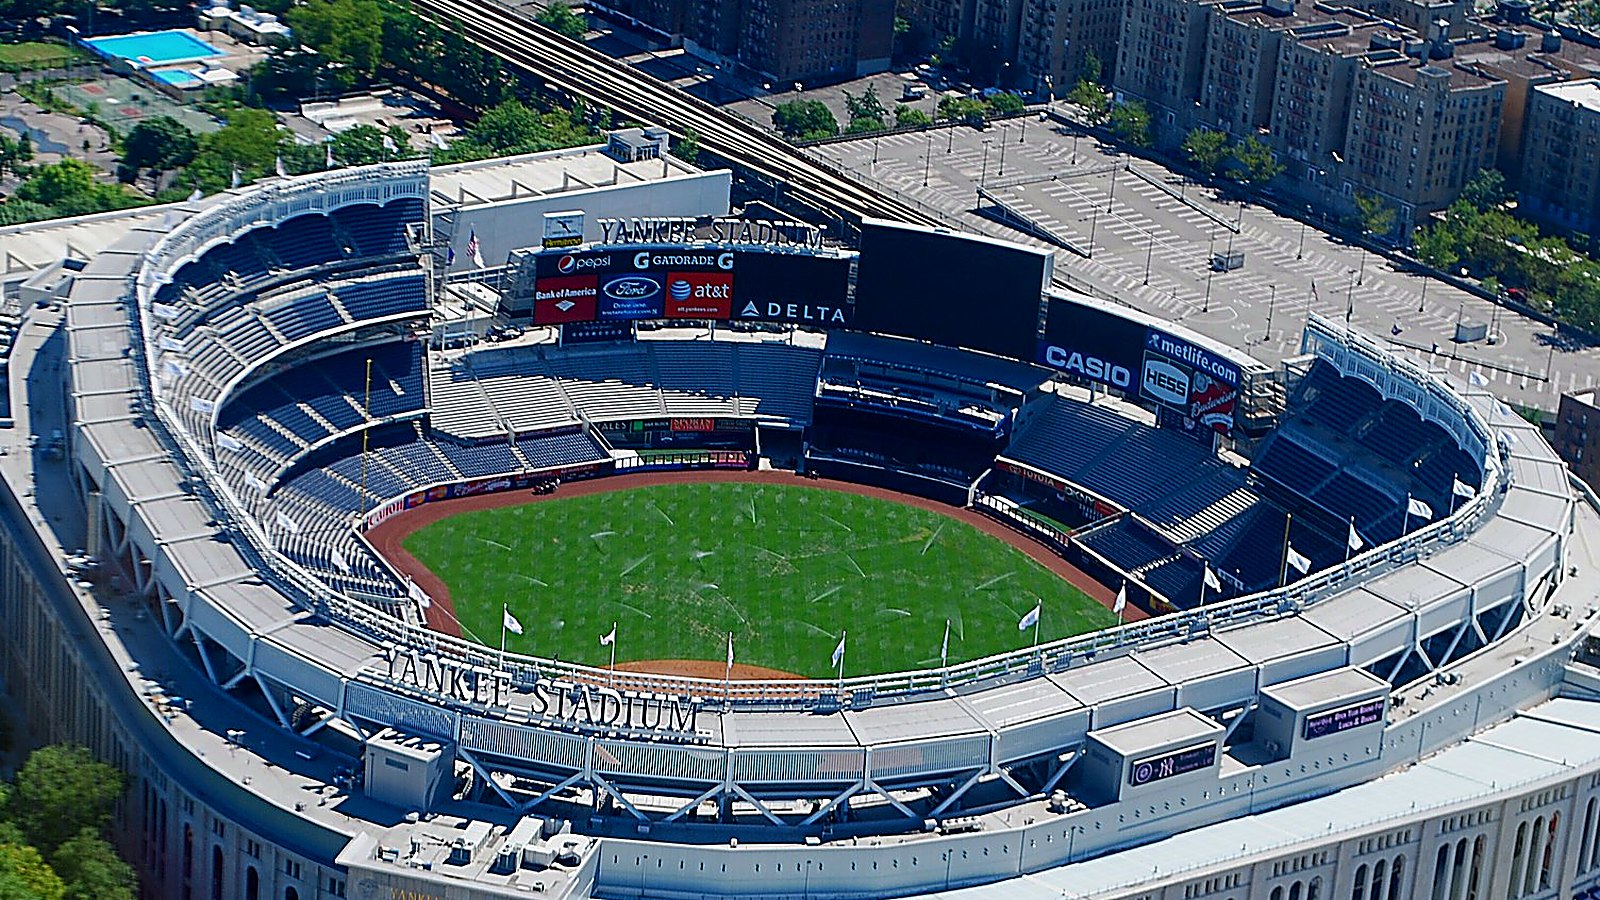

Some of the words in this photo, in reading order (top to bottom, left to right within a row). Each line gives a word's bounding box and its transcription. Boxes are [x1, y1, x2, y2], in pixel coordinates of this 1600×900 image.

[545, 238, 581, 247] Armitron
[597, 218, 697, 245] YANKEE
[708, 218, 828, 249] STADIUM
[576, 255, 611, 270] pepsi
[652, 255, 714, 266] GATORADE
[536, 290, 555, 300] Bank
[556, 289, 564, 299] of
[564, 287, 597, 298] America
[615, 282, 648, 295] Ford
[694, 283, 730, 299] at&t
[768, 302, 846, 324] DELTA
[1046, 345, 1131, 387] CASIO
[1161, 338, 1237, 384] metlife.com
[1145, 367, 1187, 396] HESS
[1190, 390, 1237, 418] Budweiser
[1022, 467, 1055, 487] TOYOTA
[381, 641, 513, 709] YANKEE
[531, 678, 703, 735] STADIUM
